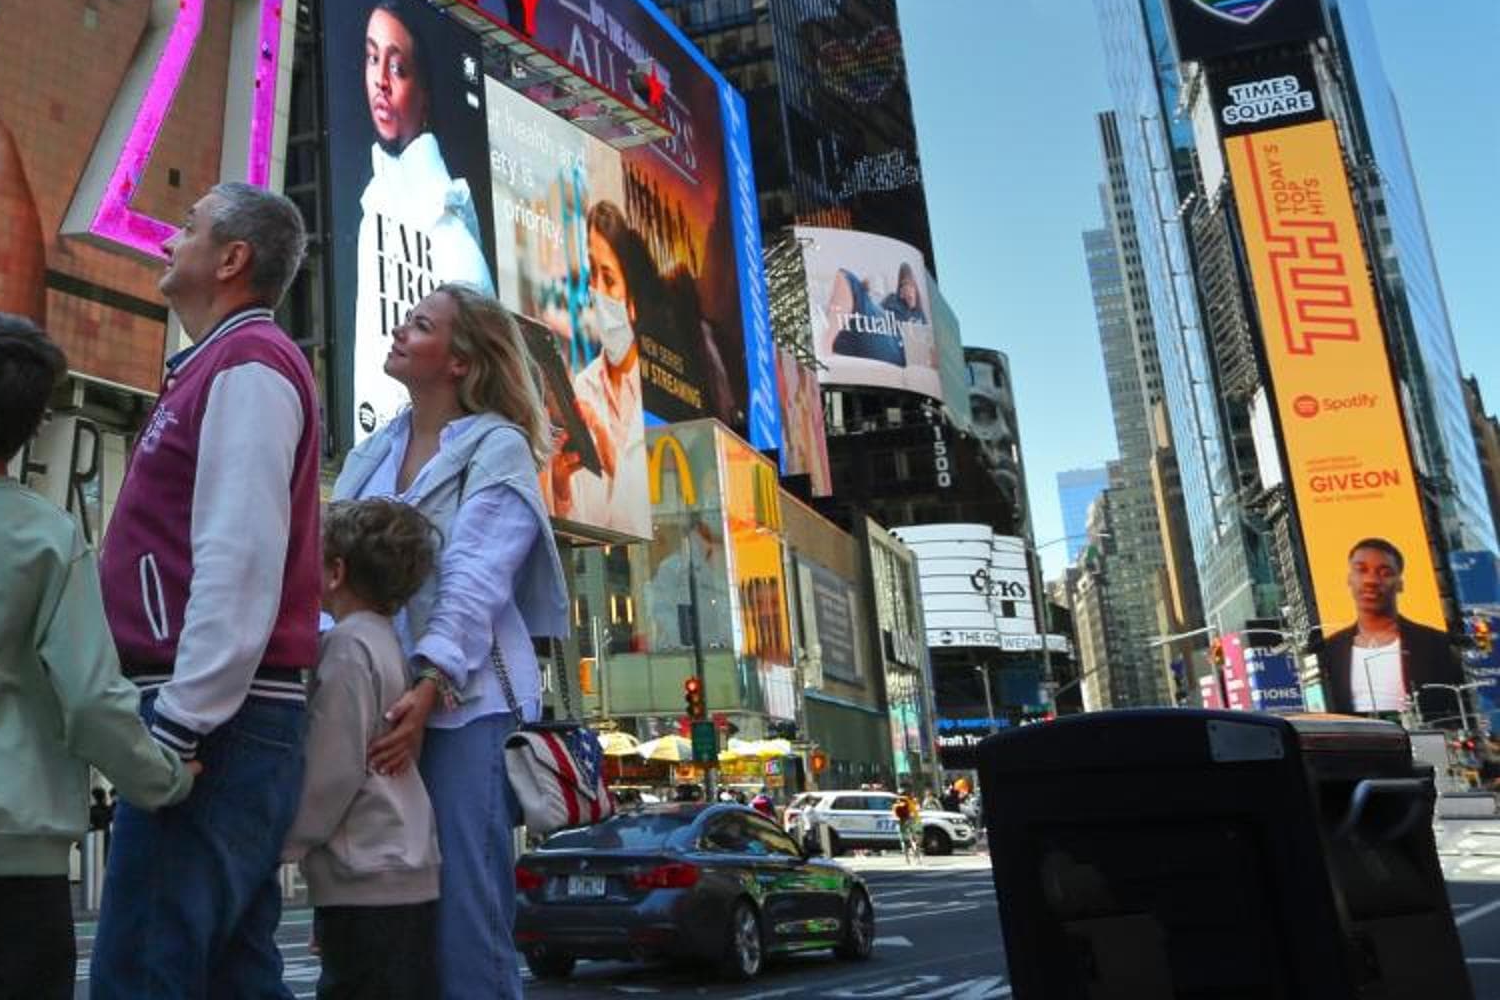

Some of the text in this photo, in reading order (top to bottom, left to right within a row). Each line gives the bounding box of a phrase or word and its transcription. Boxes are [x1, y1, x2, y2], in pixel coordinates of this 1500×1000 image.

[1230, 77, 1298, 103] TIMES
[1224, 93, 1313, 122] SQUARE
[1264, 143, 1289, 214] TODAY'S
[1288, 181, 1306, 214] TOP
[1303, 176, 1325, 216] HITS
[378, 254, 445, 305] FRO
[1321, 393, 1379, 412] Spotify
[933, 425, 952, 488] 1500
[1310, 469, 1400, 493] GIVEON
